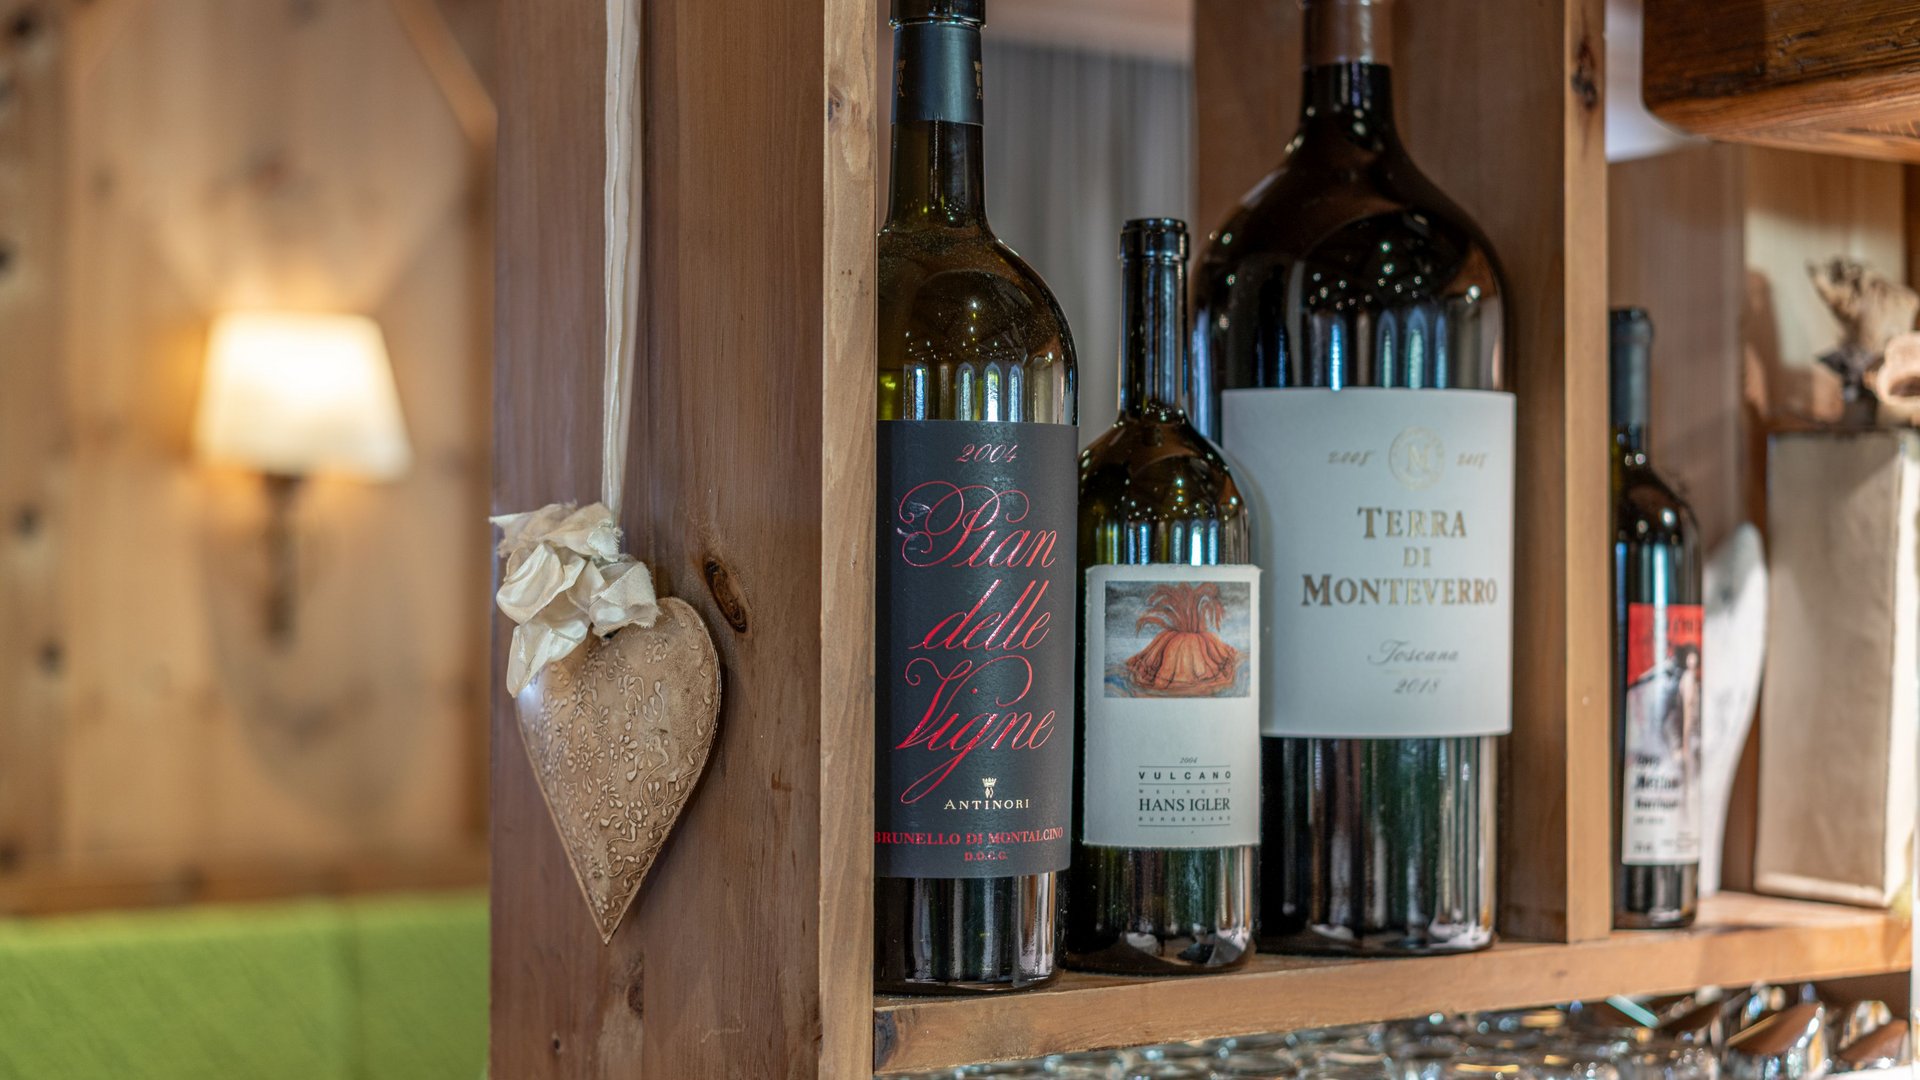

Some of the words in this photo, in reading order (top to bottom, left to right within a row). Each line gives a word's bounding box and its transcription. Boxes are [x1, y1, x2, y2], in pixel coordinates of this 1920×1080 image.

[956, 443, 1018, 463] 2004
[899, 480, 1057, 568] Pian
[1403, 547, 1431, 567] DI
[1301, 573, 1498, 607] MONTEVERRO
[908, 579, 1051, 651] delle
[1367, 639, 1459, 666] Toscana
[1394, 678, 1441, 695] 2018
[896, 654, 1056, 805] Vigne
[1139, 770, 1231, 781] VULCANO
[943, 798, 1030, 811] ANTINORI
[1139, 798, 1185, 812] HANS
[1189, 797, 1231, 811] IGLER
[874, 831, 961, 845] BRUNELLO
[965, 832, 983, 845] DI
[988, 826, 1064, 844] MONTALCINO
